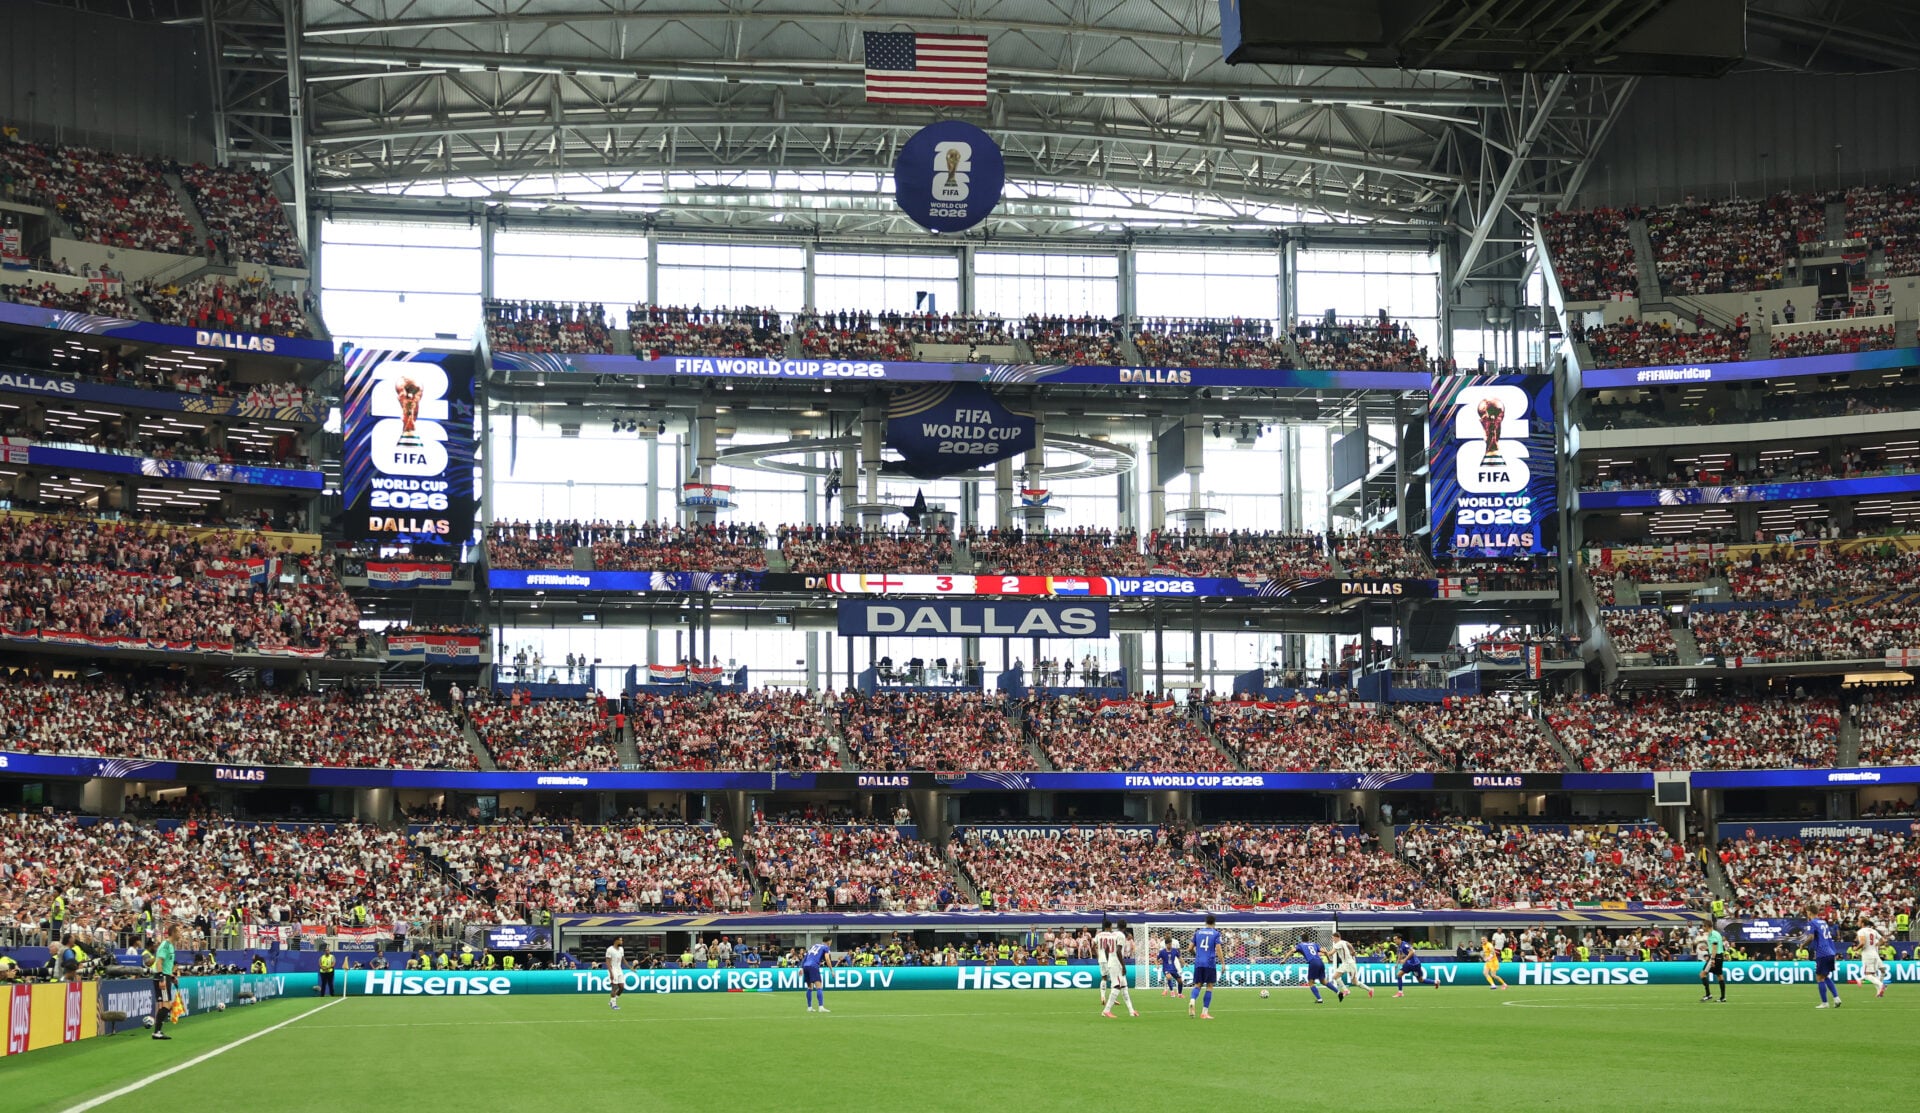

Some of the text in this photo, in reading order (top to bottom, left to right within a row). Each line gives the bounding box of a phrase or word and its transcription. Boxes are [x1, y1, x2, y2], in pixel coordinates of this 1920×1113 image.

[929, 208, 967, 218] 2026
[196, 330, 275, 352] DALLAS
[675, 358, 885, 377] FIFA WORLD CUP 2026
[1637, 368, 1711, 382] #FIFAWorldCup
[1119, 369, 1192, 383] DALLAS
[955, 408, 992, 425] FIFA
[922, 423, 1022, 440] WORLD CUP
[938, 441, 999, 455] 2026
[394, 453, 427, 465] FIFA
[1478, 471, 1511, 483] FIFA
[371, 478, 448, 492] WORLD CUP
[371, 490, 449, 510] 2026
[1457, 497, 1531, 507] WORLD CUP
[1457, 509, 1532, 525] 2026
[369, 516, 450, 534] DALLAS
[1456, 533, 1534, 548] DALLAS
[526, 574, 591, 587] #FIFAWorldCup
[936, 576, 954, 592] 3
[1001, 576, 1019, 593] 2
[1142, 580, 1195, 593] 2026
[1341, 582, 1402, 595] DALLAS
[866, 605, 1097, 635] DALLAS
[216, 768, 265, 781] DALLAS
[858, 776, 909, 787] DALLAS
[1125, 776, 1263, 786] FIFA WORLD CUP 2026
[1473, 776, 1522, 786] DALLAS
[1799, 826, 1873, 838] #FIFAWorldCup
[1200, 936, 1209, 951] 4
[1307, 945, 1317, 956] 8
[957, 967, 1093, 990] Hisense
[1153, 966, 1194, 984] Te
[1271, 965, 1292, 984] of
[1430, 965, 1458, 983] TV
[1518, 963, 1649, 985] Hisense
[1749, 962, 1813, 984] Origin
[364, 970, 511, 995] Hisense
[573, 969, 895, 993] The Origin of RGB MiiLED TV
